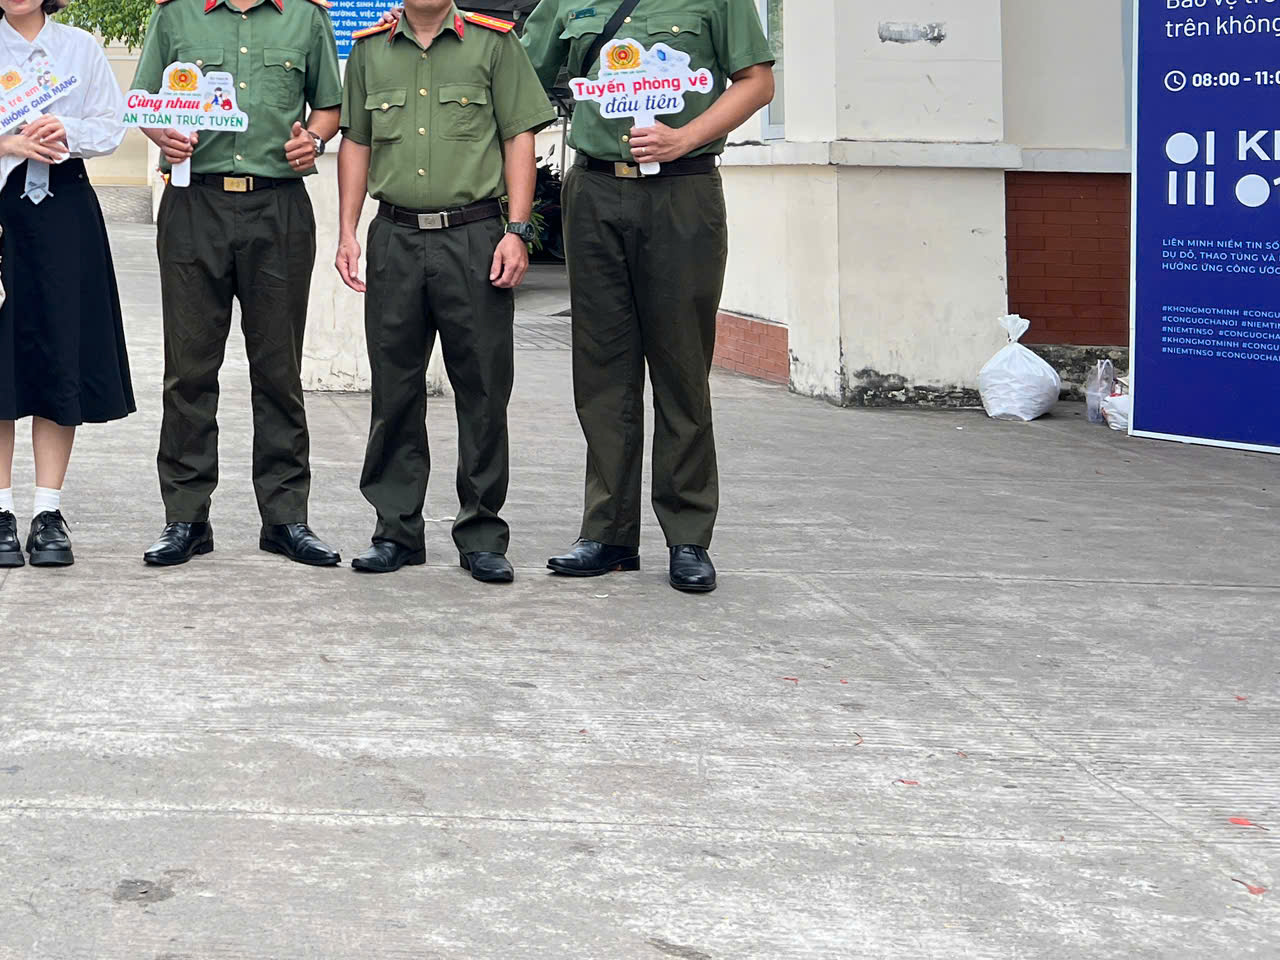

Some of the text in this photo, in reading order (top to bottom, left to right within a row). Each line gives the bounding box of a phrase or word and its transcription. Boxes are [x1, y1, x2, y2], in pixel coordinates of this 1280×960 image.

[1165, 17, 1210, 38] trên
[575, 72, 708, 98] Tuyến phòng vệ
[1192, 72, 1240, 88] 08:00
[127, 94, 201, 112] Cùng nhau
[605, 93, 678, 113] đầu tiên
[122, 112, 138, 123] AN
[142, 111, 172, 124] TOÀN
[1187, 239, 1214, 247] MINH
[1245, 241, 1263, 249] TIN
[1200, 251, 1228, 260] THAO
[1162, 305, 1240, 316] #KHONGMOTMINH
[1216, 351, 1280, 362] #CONGUOCHA
